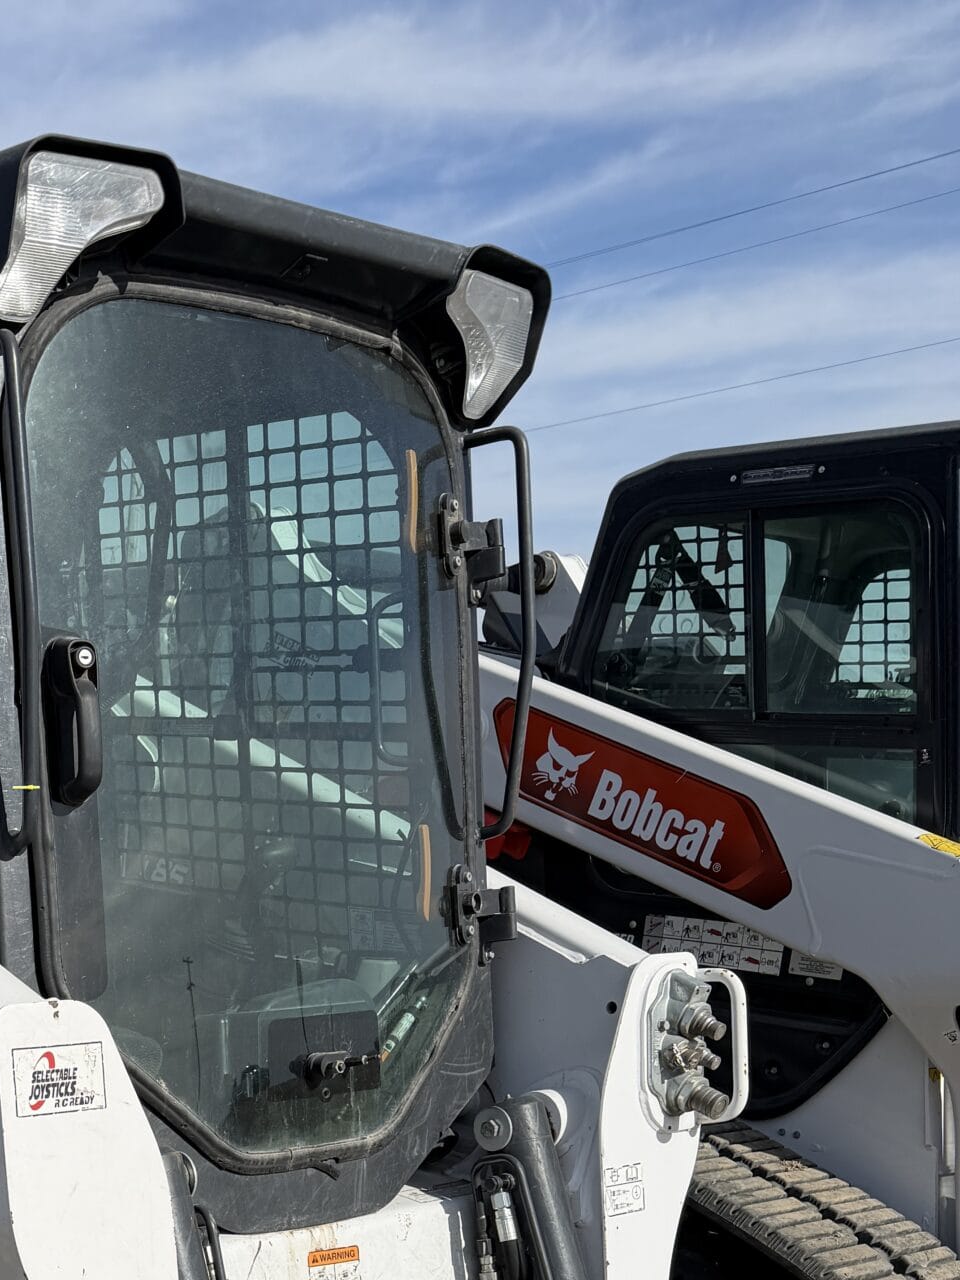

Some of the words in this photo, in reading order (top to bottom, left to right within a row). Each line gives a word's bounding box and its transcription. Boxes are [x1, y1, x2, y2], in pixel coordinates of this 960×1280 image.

[587, 768, 726, 870] Bobcat
[31, 1067, 78, 1084] SELECTABLE
[29, 1081, 77, 1101] JOYSTICKS
[319, 1249, 356, 1262] WARNING
